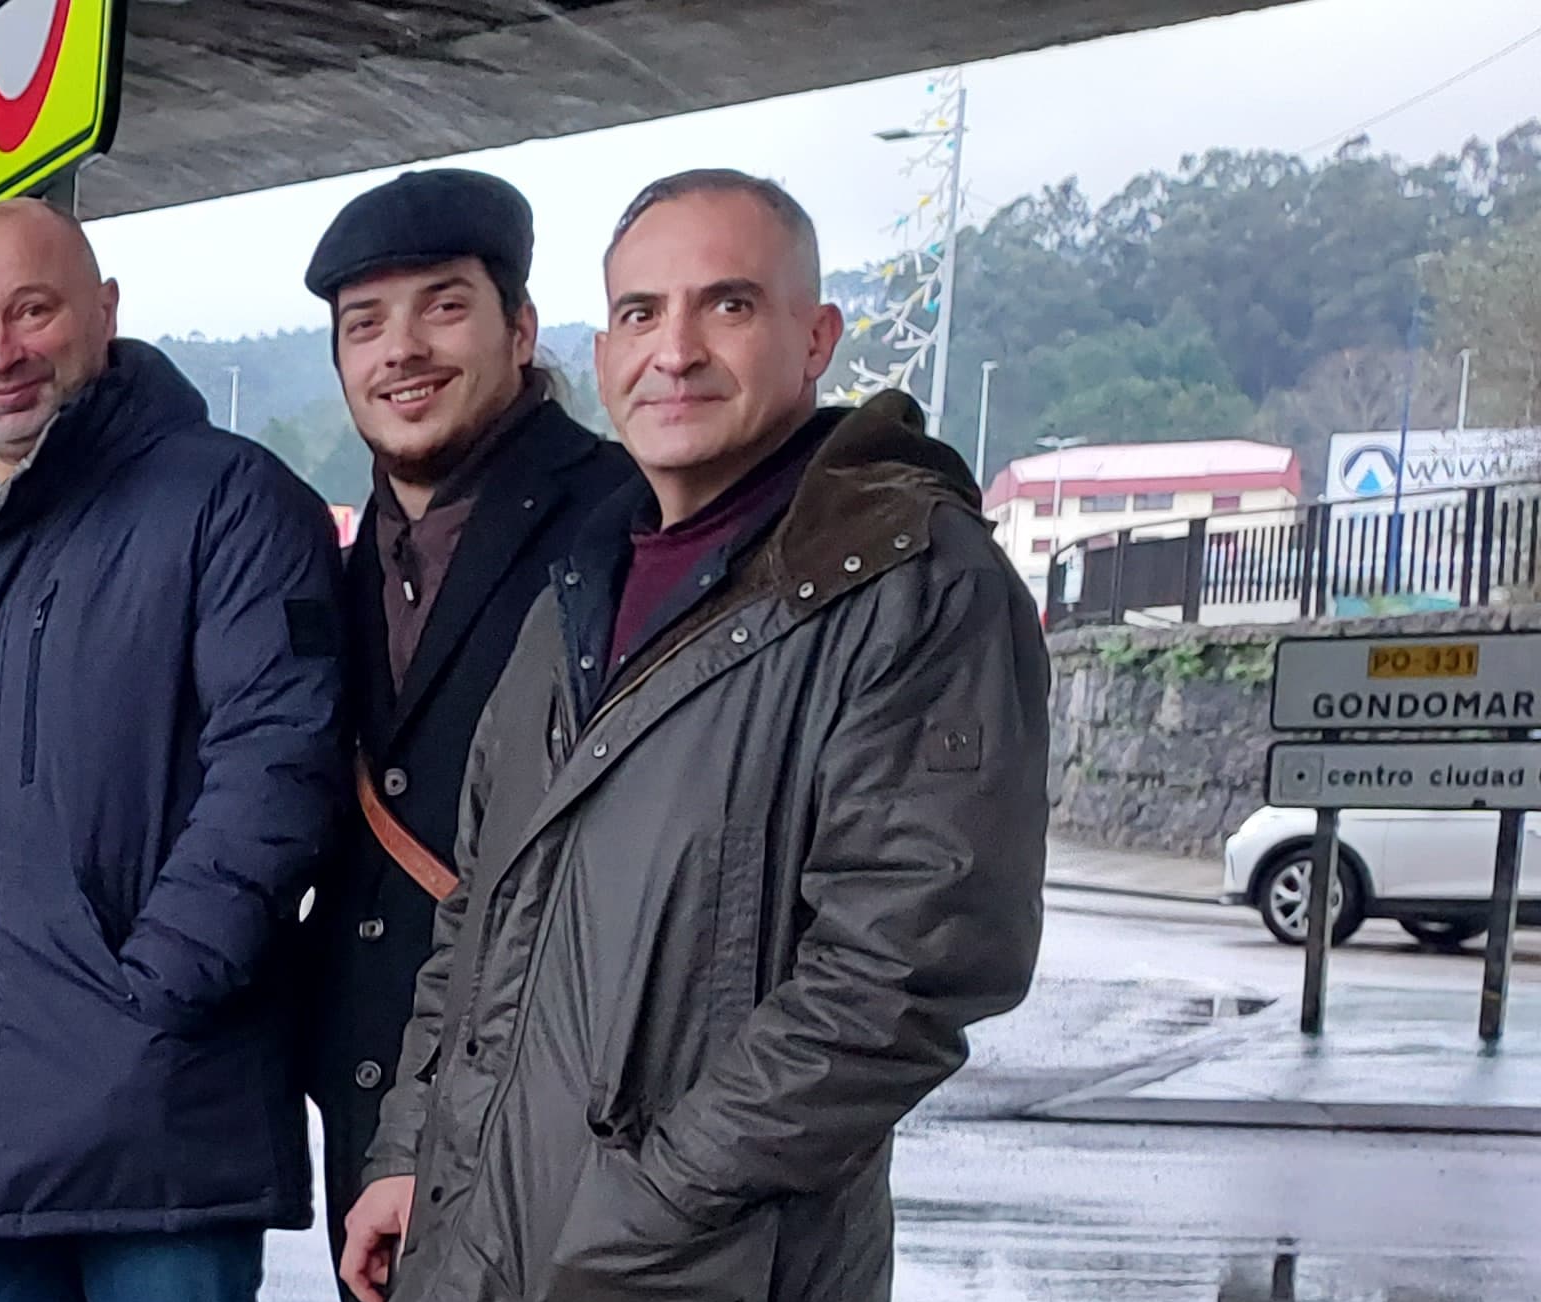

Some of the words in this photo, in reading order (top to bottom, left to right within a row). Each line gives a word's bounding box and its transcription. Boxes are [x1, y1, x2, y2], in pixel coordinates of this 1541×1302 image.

[1313, 691, 1535, 719] GONDOMAR
[1327, 764, 1413, 786] centro
[1429, 763, 1525, 787] ciudad
